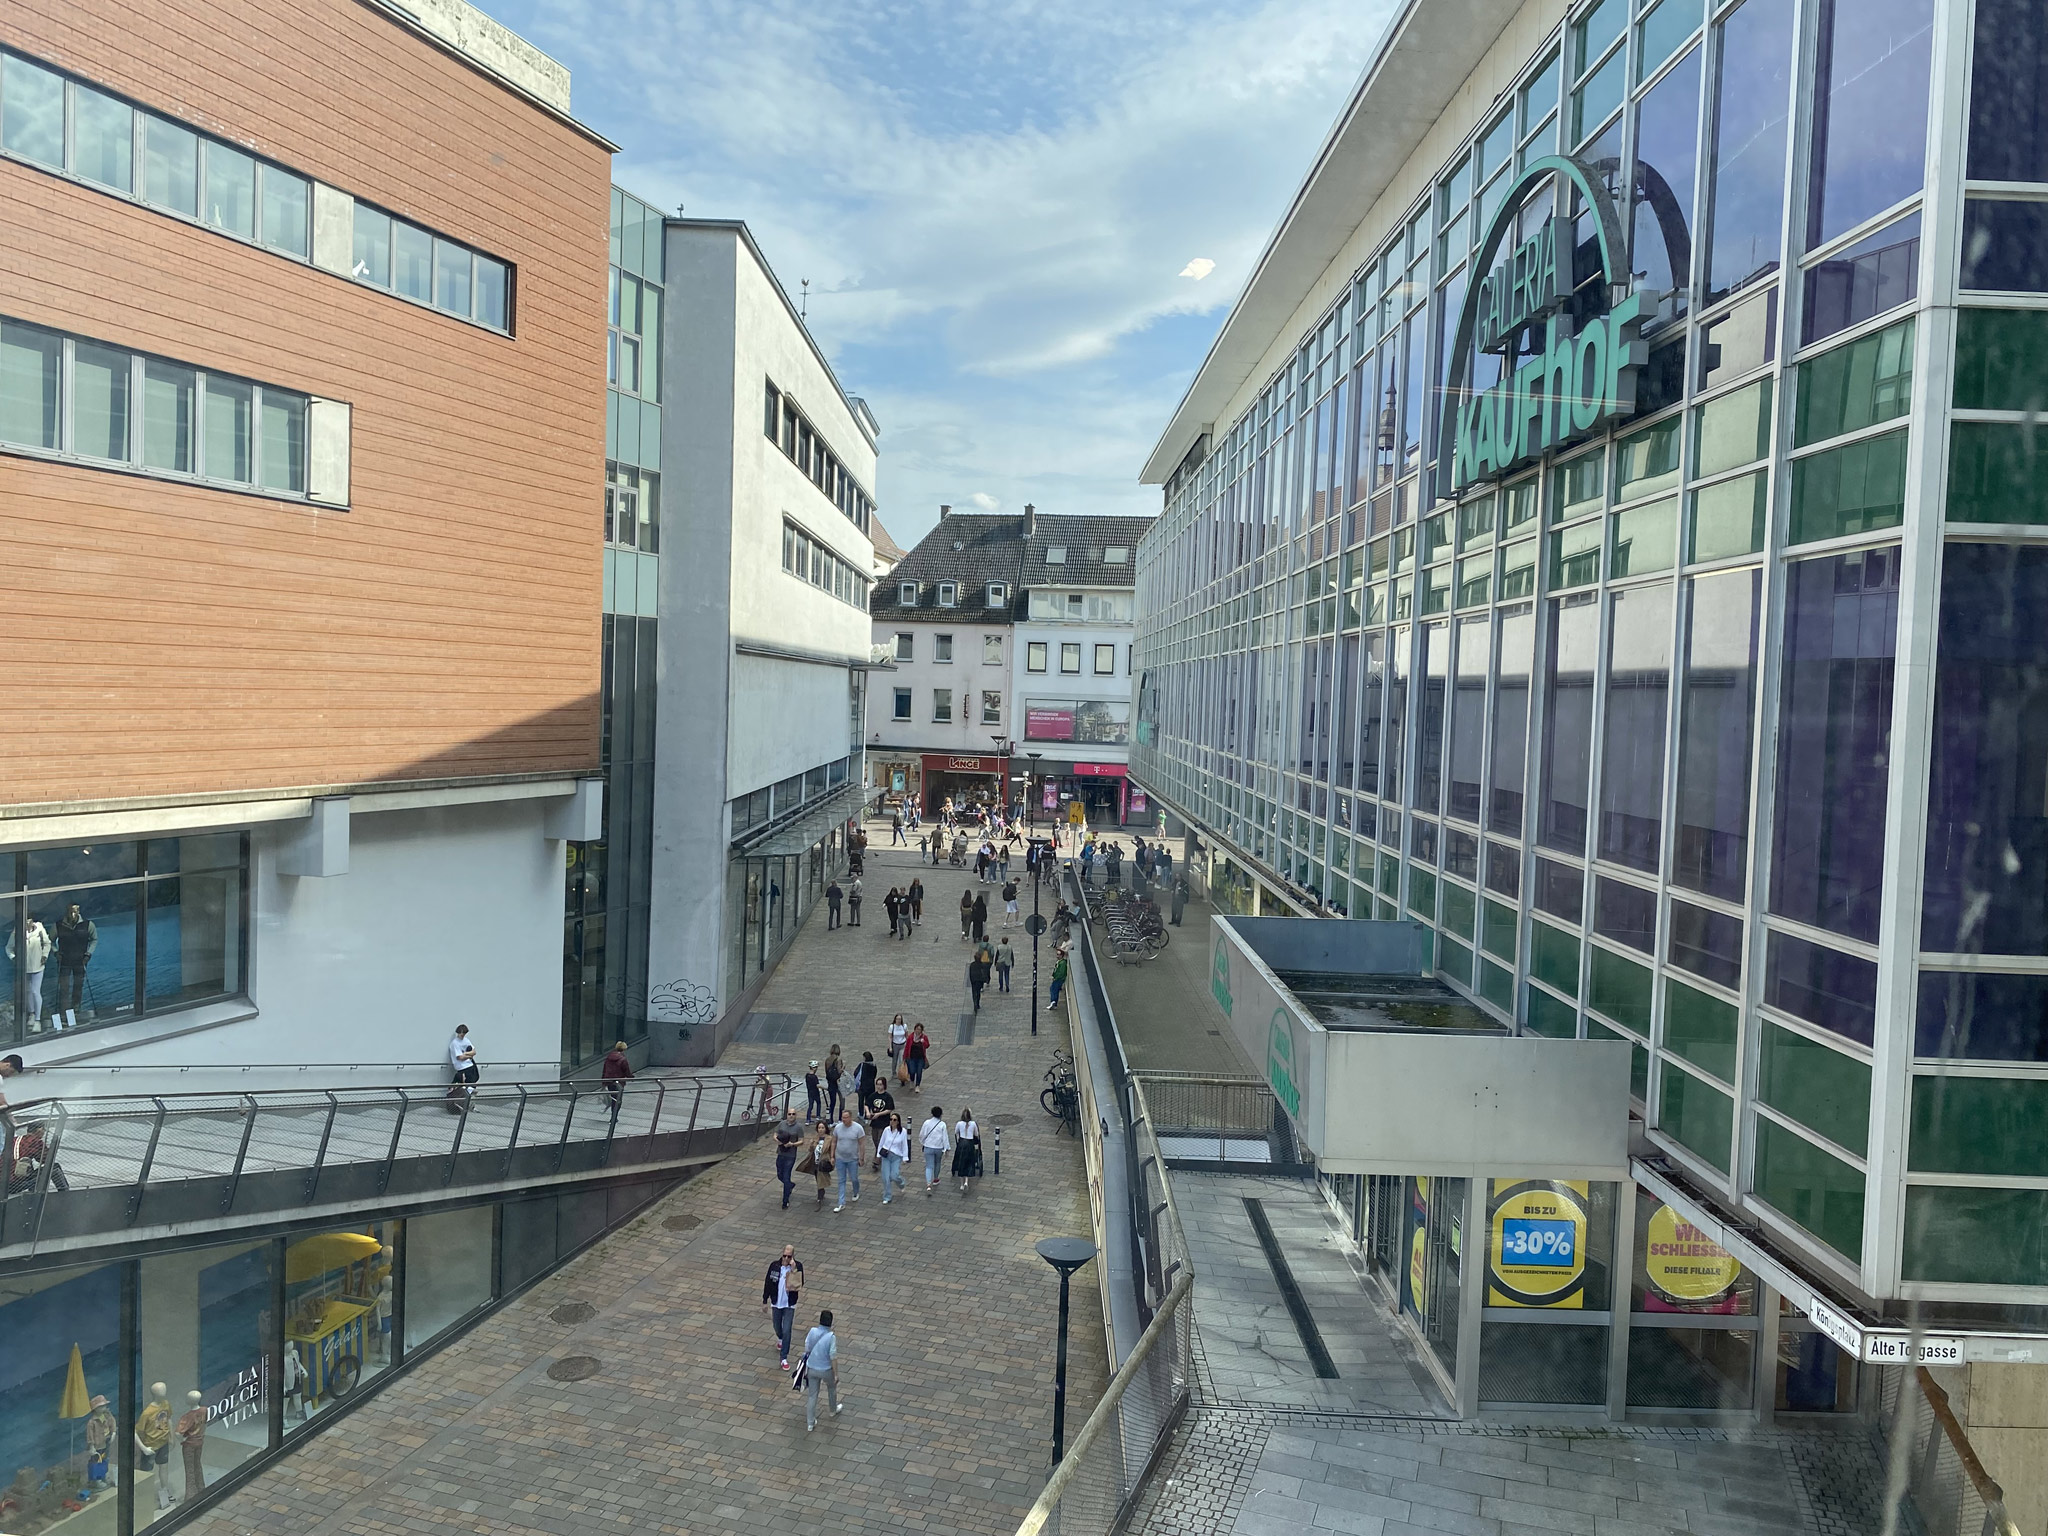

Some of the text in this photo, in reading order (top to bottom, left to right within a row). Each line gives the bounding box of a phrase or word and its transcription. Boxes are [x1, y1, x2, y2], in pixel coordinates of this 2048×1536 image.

[1476, 219, 1559, 353] GALERIA
[1524, 1206, 1556, 1215] BIS ZU
[1506, 1231, 1570, 1256] -30%
[1664, 1266, 1721, 1275] DIESE FILIALE
[323, 1322, 361, 1362] Gelati
[1871, 1340, 1957, 1361] Alte Togasse
[238, 1365, 258, 1387] LA
[206, 1381, 259, 1422] DOLCE
[222, 1401, 259, 1429] VITA
